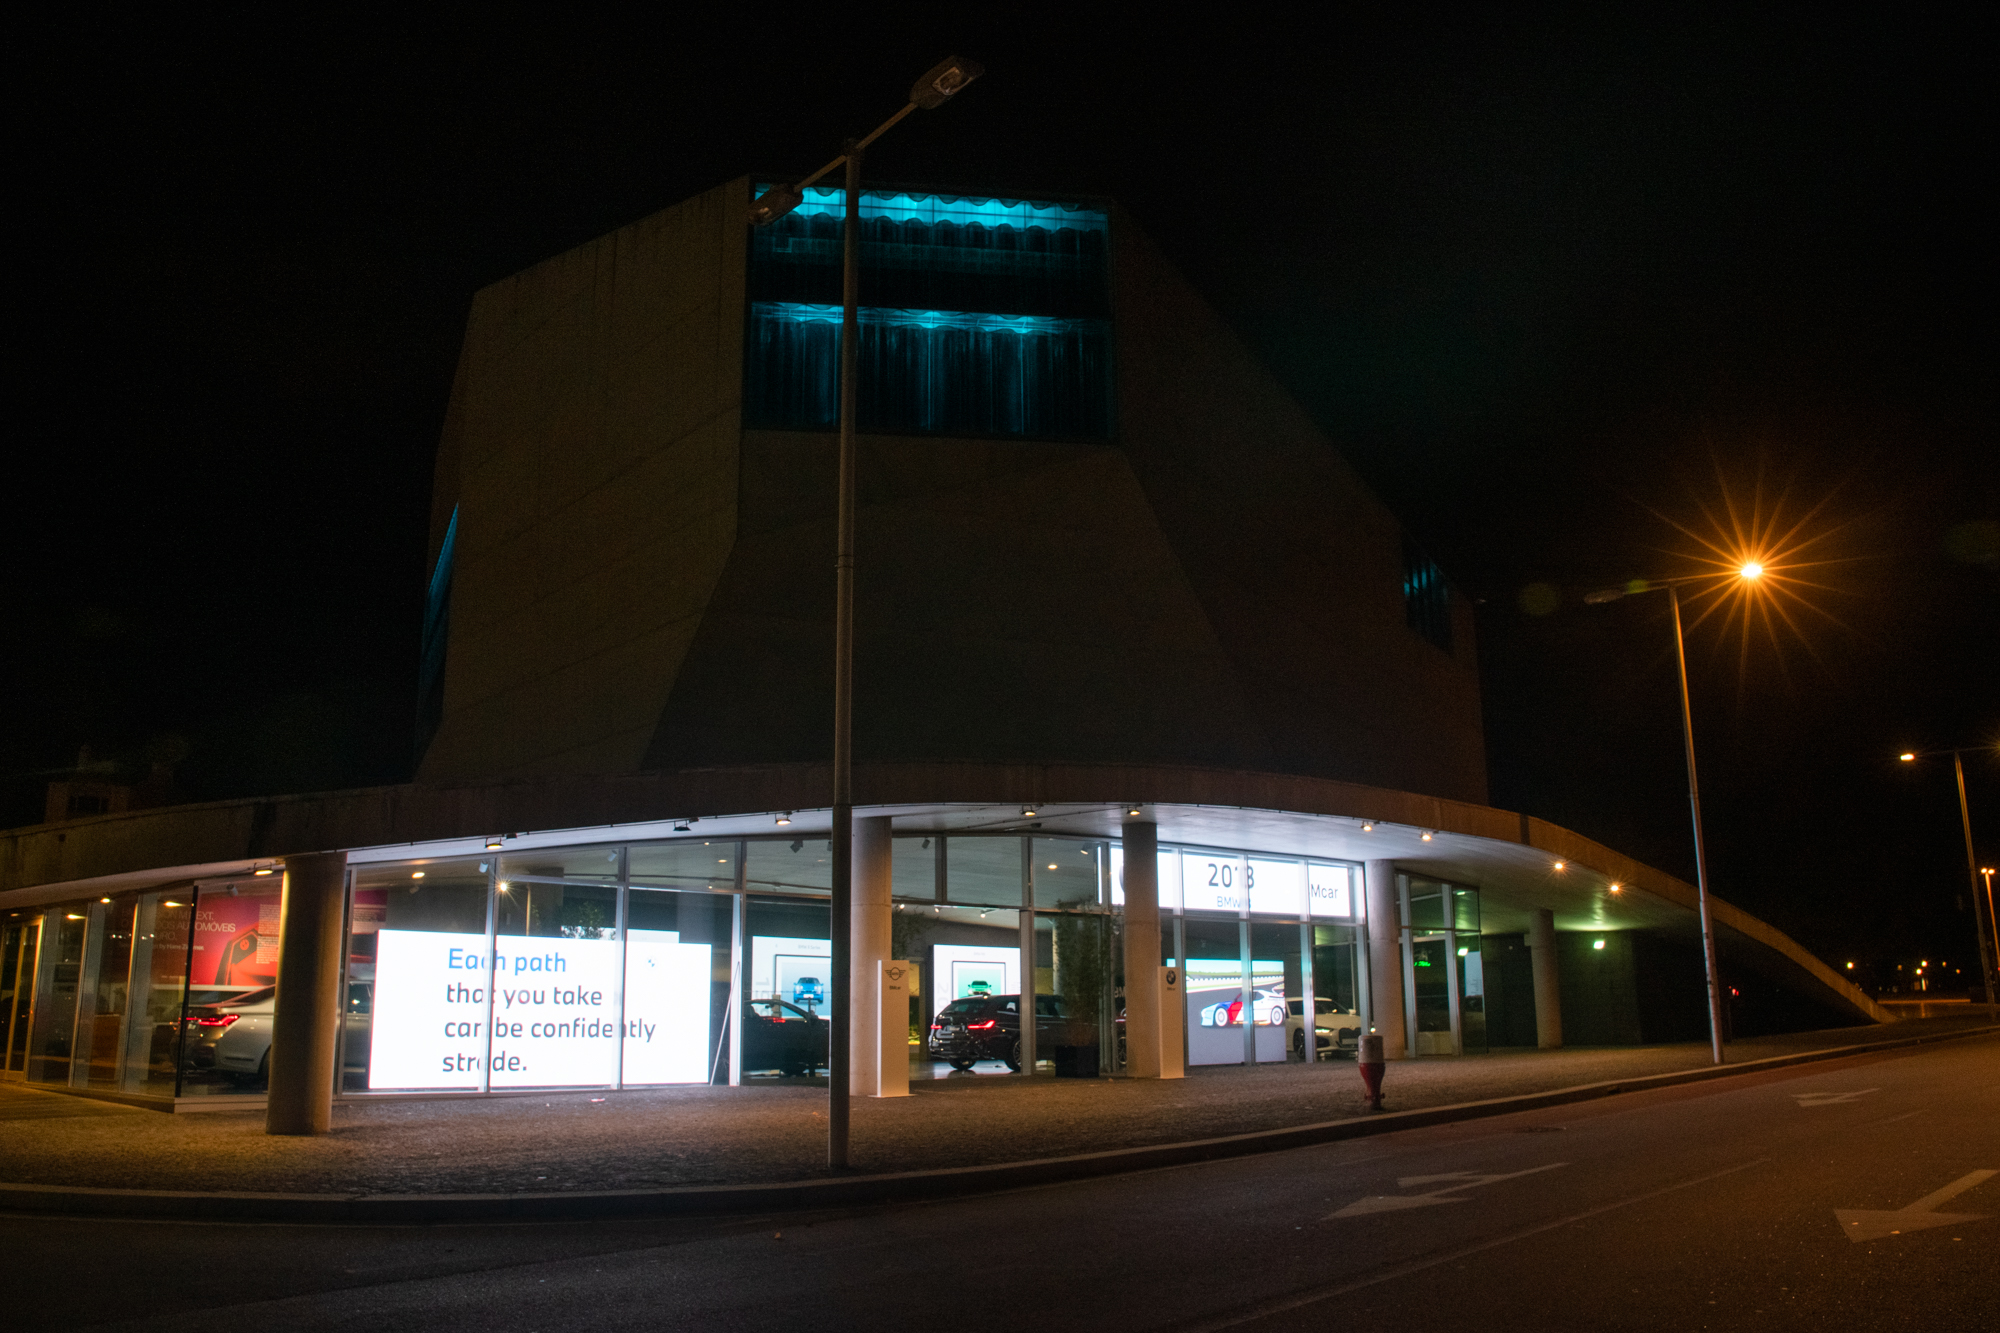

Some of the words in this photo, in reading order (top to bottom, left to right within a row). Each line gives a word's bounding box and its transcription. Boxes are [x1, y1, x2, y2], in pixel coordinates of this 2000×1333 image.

[177, 921, 236, 933] AUOMÓVEIS
[189, 911, 215, 921] EXT.
[514, 952, 567, 976] path
[502, 988, 545, 1009] you
[553, 984, 603, 1006] take
[495, 1016, 523, 1038] be
